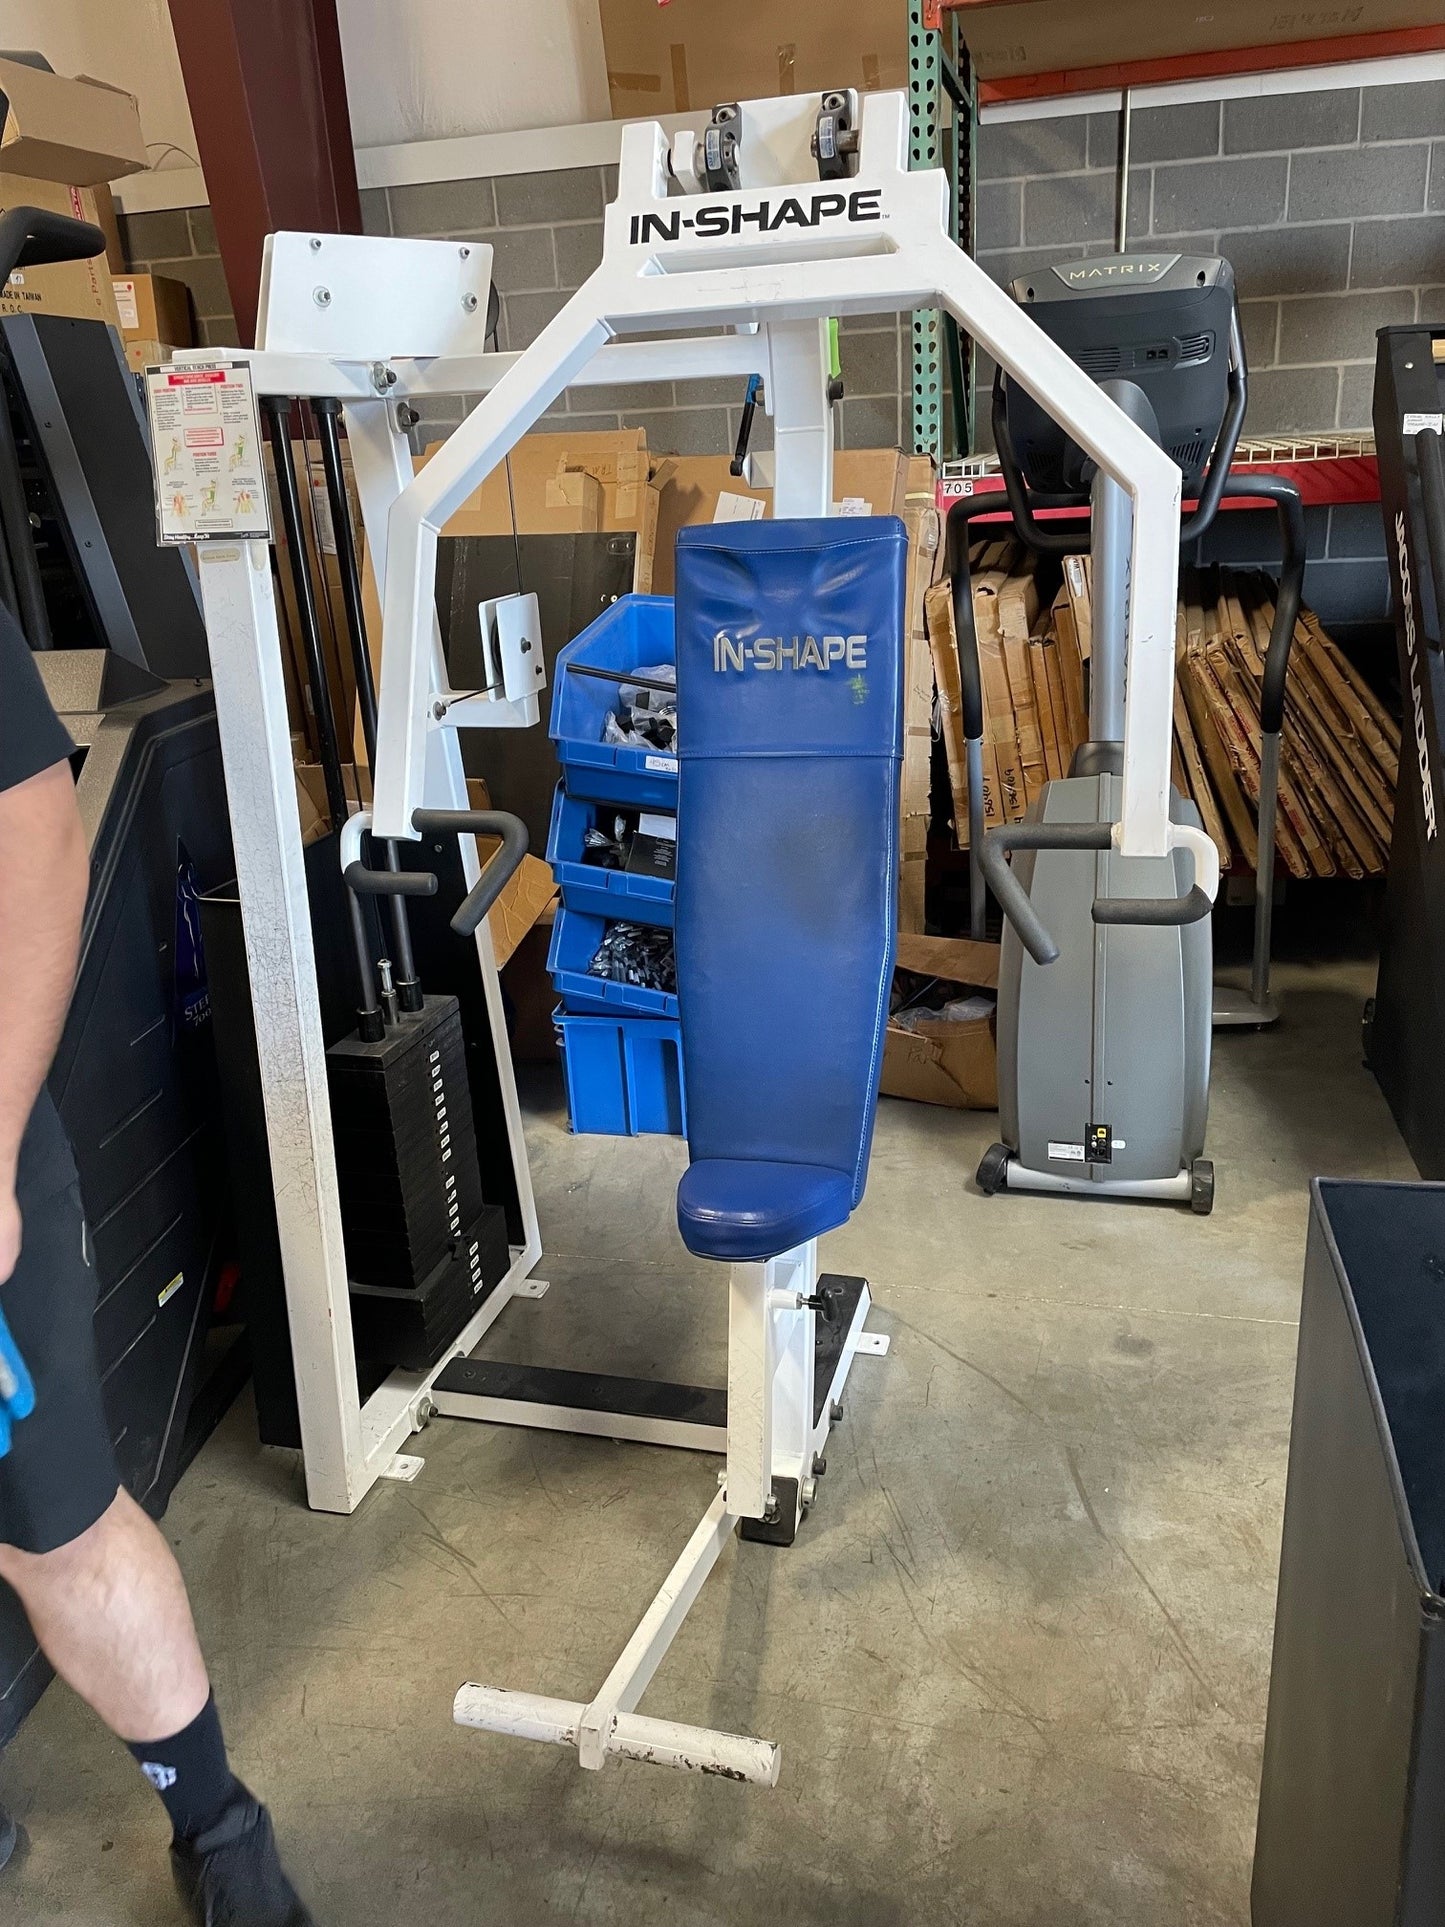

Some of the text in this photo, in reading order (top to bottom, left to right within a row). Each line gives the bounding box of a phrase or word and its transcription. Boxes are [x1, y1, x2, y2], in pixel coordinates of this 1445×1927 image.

[630, 189, 882, 244] IN-SHAPE
[1069, 264, 1160, 280] MATRIX
[945, 482, 972, 494] 705
[714, 632, 868, 673] IN-SHAPE
[1395, 510, 1436, 842] JACOBS LADDER
